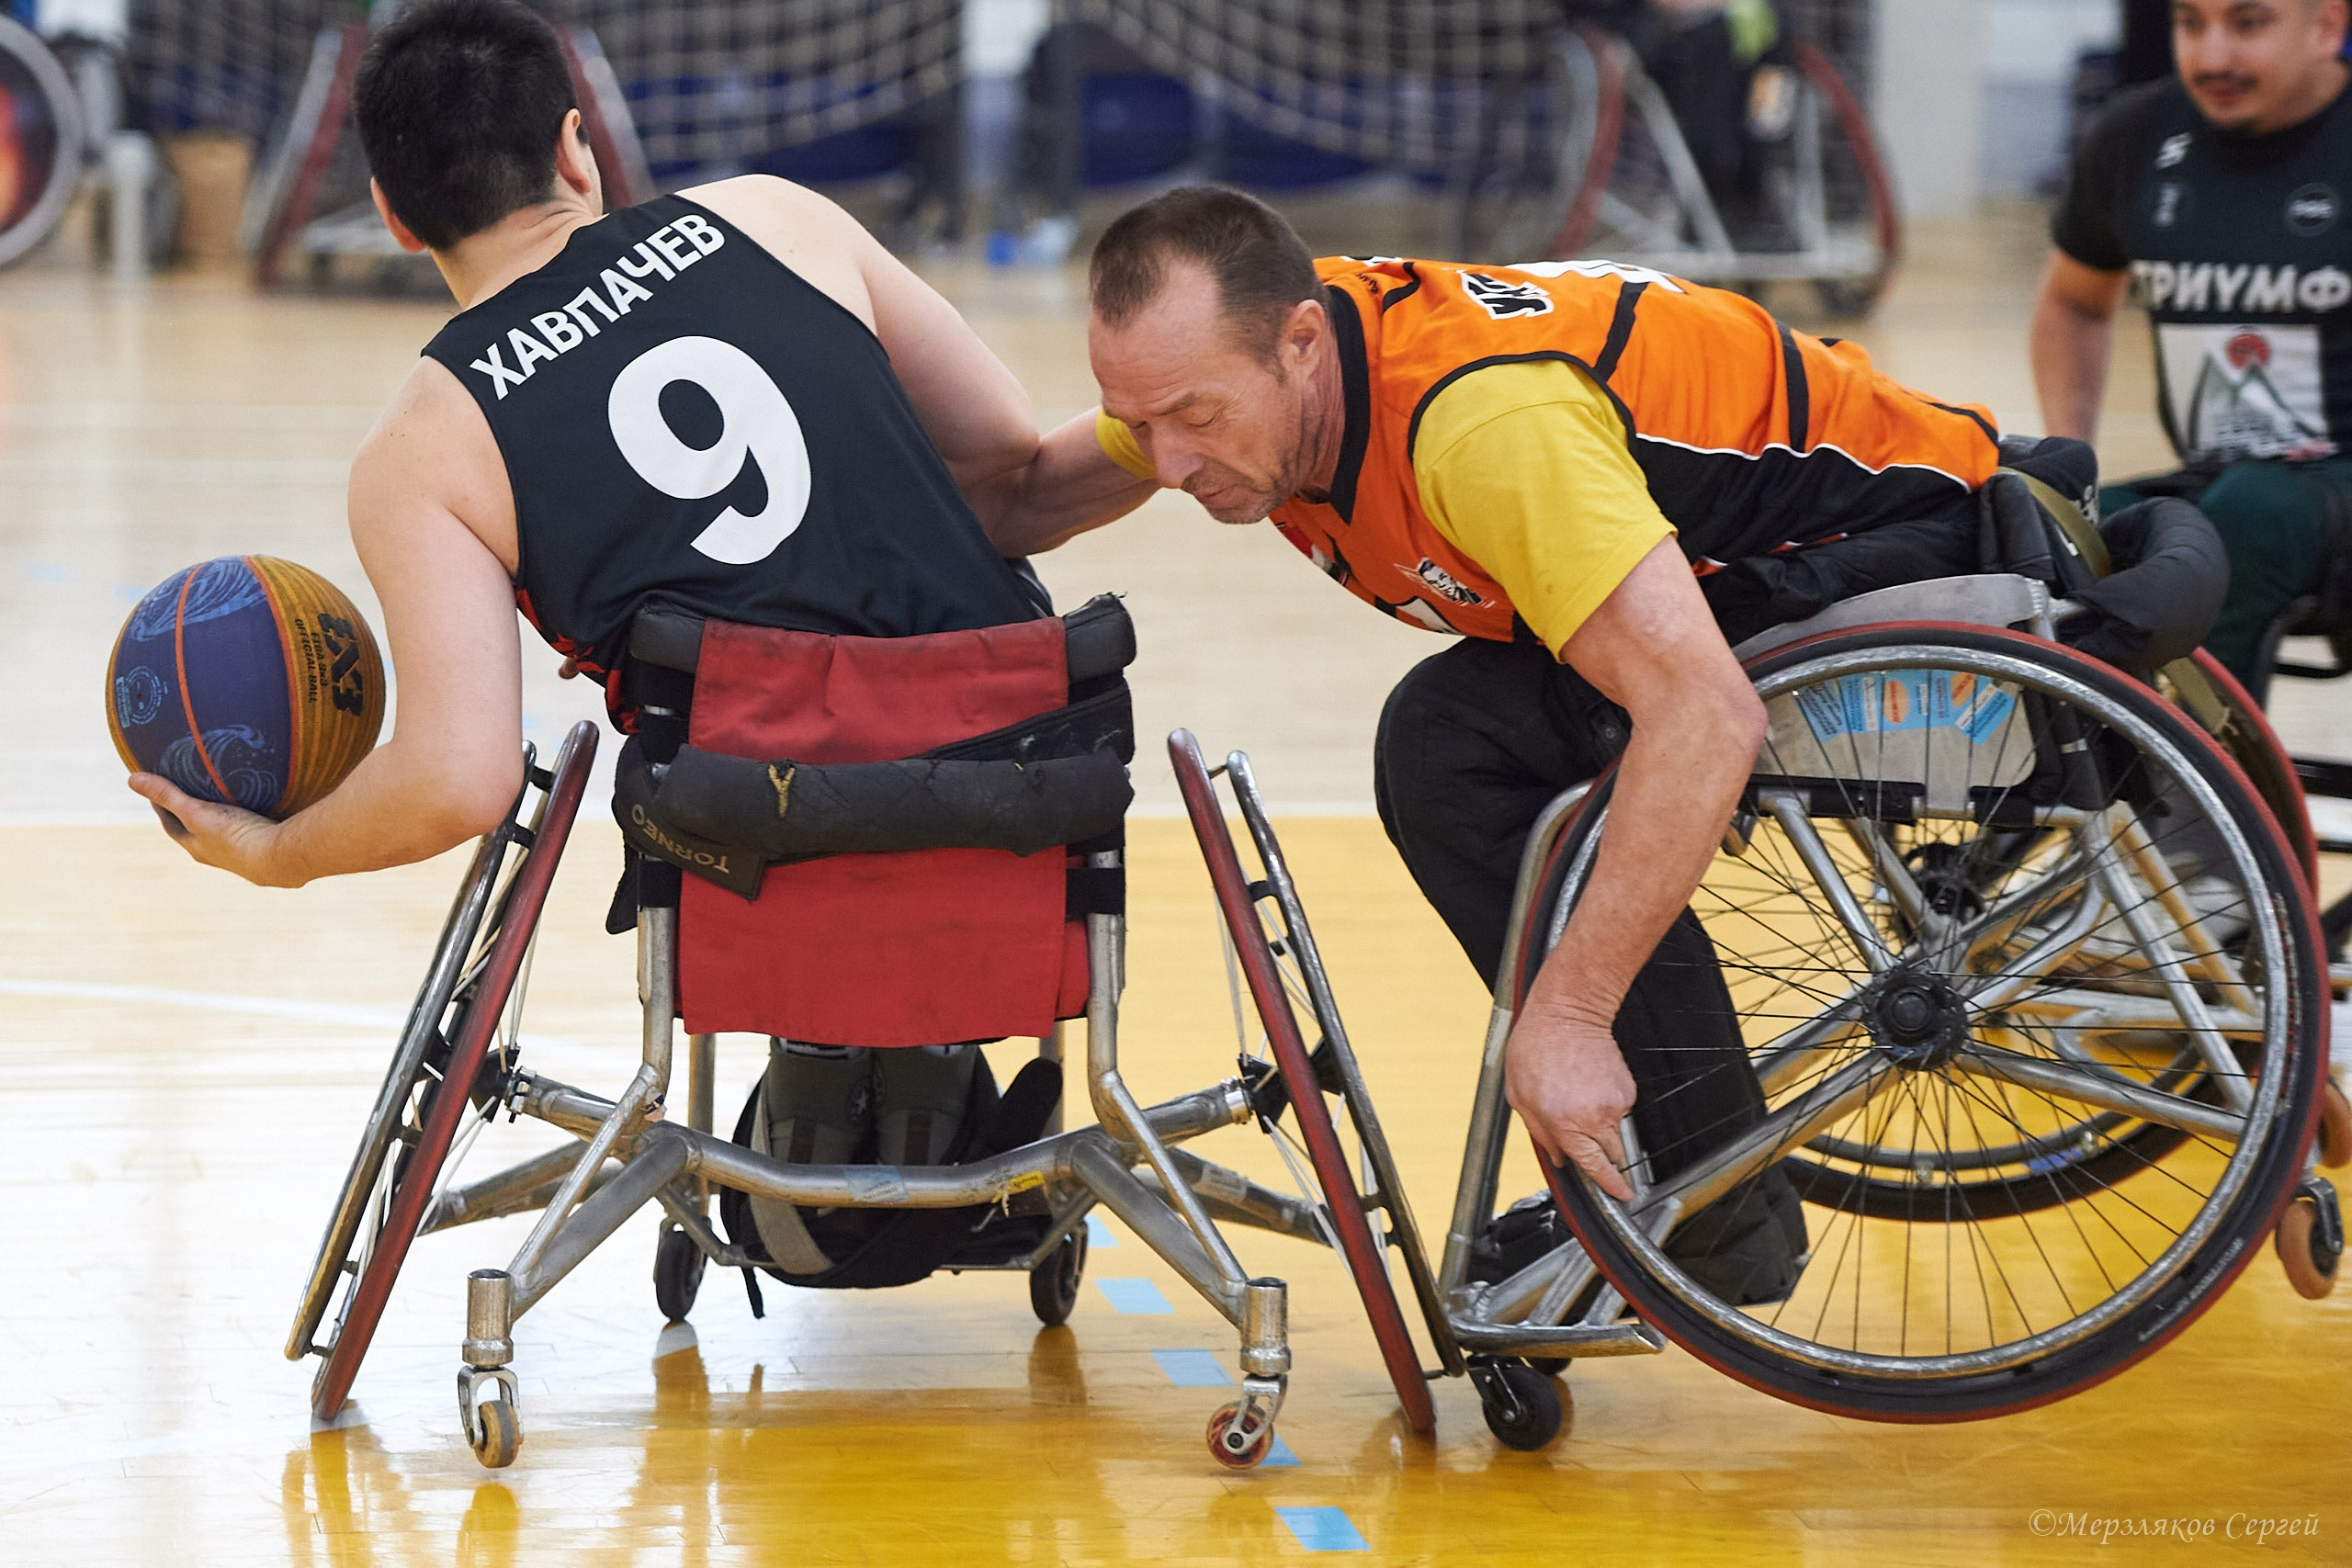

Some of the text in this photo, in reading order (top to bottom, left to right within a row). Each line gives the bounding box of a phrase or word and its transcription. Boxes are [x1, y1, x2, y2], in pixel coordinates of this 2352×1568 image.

[469, 213, 726, 400] ХАВПАЧЕВ
[2131, 260, 2352, 312] ТРИУМФ
[607, 334, 811, 565] 9
[294, 618, 319, 703] OFFICIAL BALL
[311, 629, 325, 662] FIBA
[632, 804, 729, 874] TORNEO
